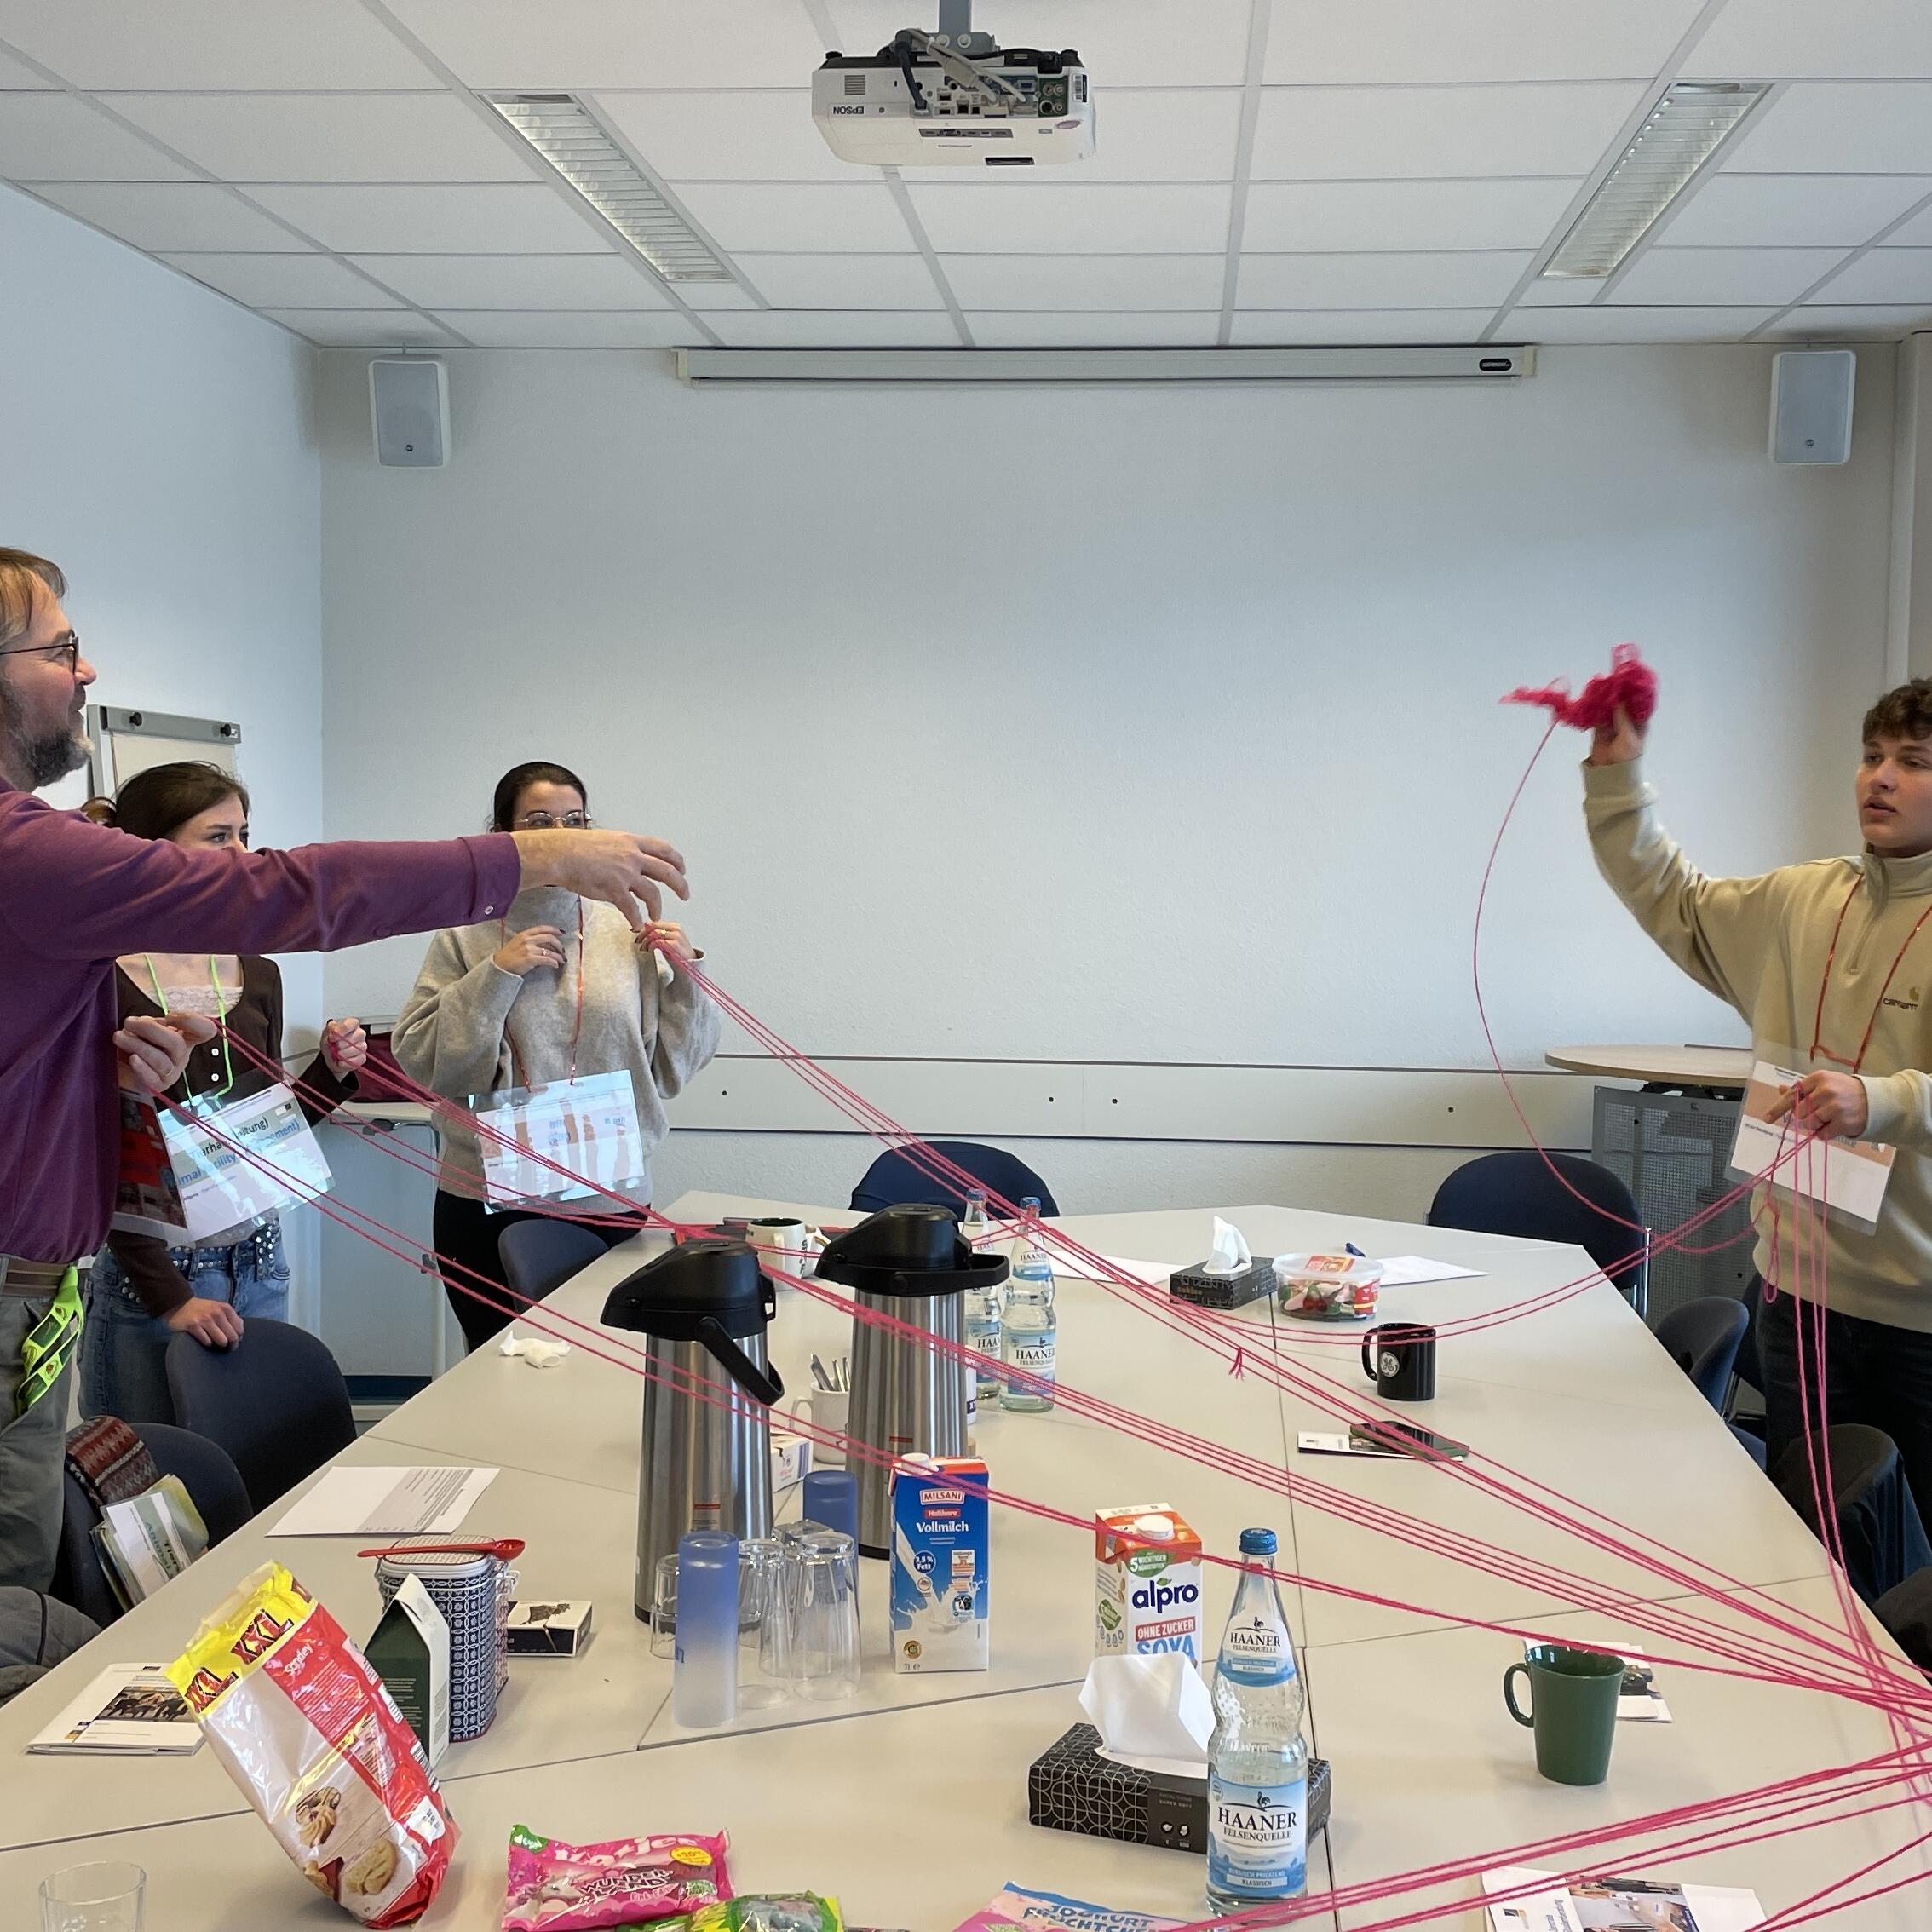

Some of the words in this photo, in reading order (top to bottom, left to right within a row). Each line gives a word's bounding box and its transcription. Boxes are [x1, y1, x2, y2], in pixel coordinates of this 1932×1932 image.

[833, 106, 865, 115] EPSON
[924, 1492, 962, 1500] MILSANI
[916, 1521, 969, 1533] Vollmilch
[1130, 1557, 1139, 1573] 5
[1132, 1579, 1199, 1614] alpro
[229, 1608, 295, 1665] XXL
[1137, 1624, 1161, 1640] OHNE
[1161, 1619, 1194, 1636] ZUCKER
[1230, 1631, 1281, 1647] HAANER
[1217, 1806, 1297, 1831] HAANER
[1223, 1826, 1292, 1843] FELSENQUELLE
[1241, 1878, 1273, 1887] KLASSISCH
[1050, 1905, 1155, 1928] JOGHURT
